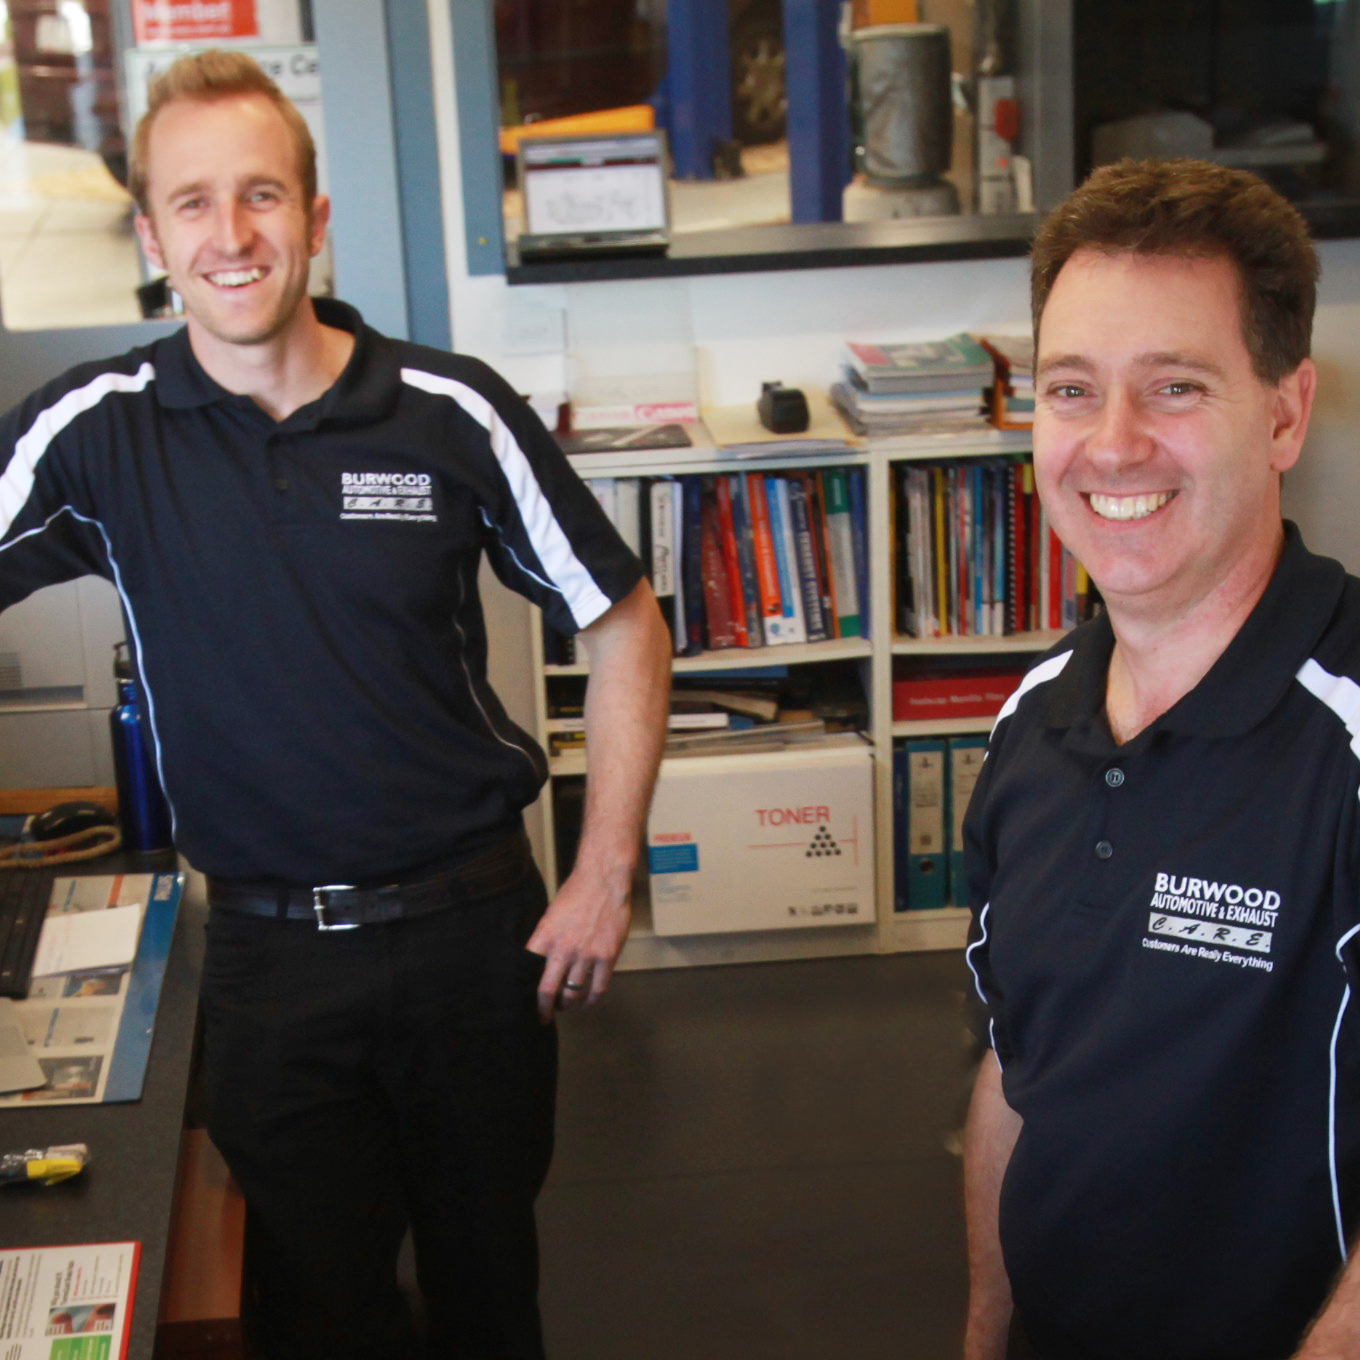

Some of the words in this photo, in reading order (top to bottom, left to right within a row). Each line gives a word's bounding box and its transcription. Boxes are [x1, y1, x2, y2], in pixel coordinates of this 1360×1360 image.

[341, 472, 432, 486] BURWOOD
[755, 805, 831, 827] TONER
[1154, 872, 1281, 911] BURWOOD
[1150, 892, 1219, 918] AUTOMOTIVE
[1218, 906, 1225, 920] &
[1226, 905, 1278, 928] EXHAUST
[1142, 937, 1180, 953] Customers
[1181, 944, 1198, 956] Are
[1198, 947, 1222, 962] Really
[1222, 951, 1274, 972] Everything
